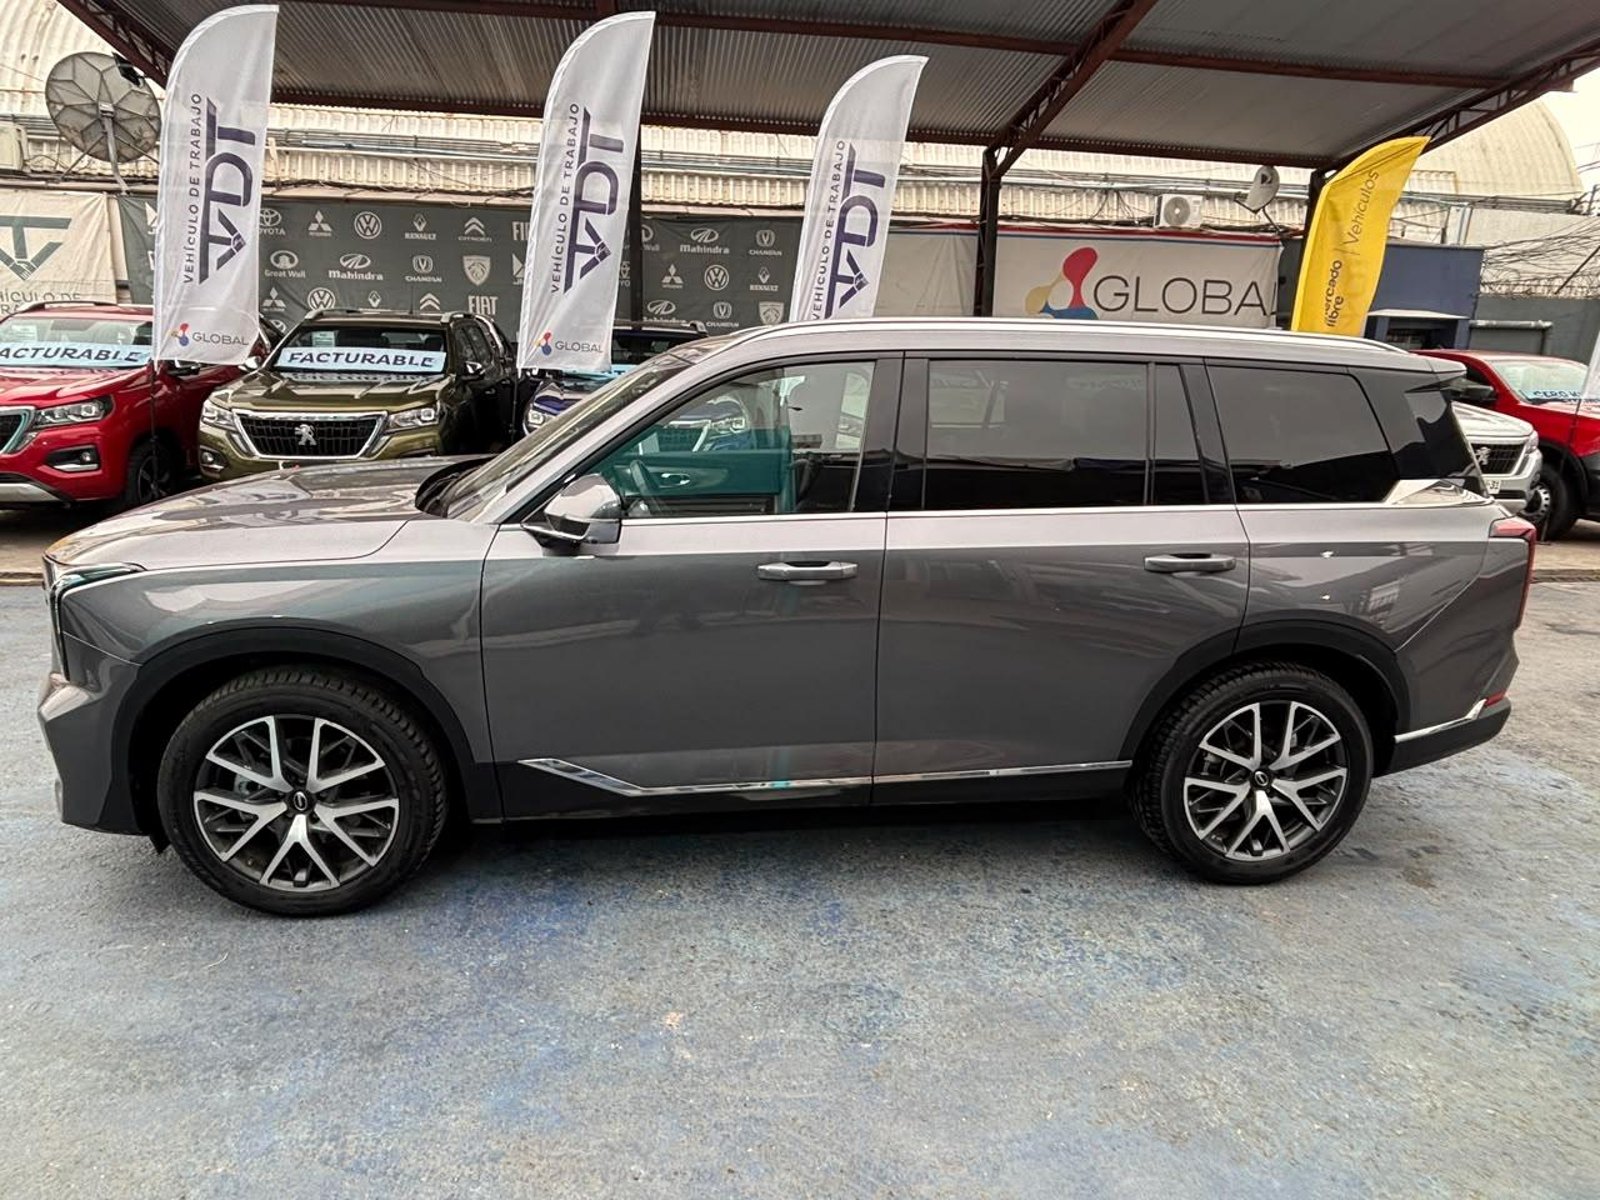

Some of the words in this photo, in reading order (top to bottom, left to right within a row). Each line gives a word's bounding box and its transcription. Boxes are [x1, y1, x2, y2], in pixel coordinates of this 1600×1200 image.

[189, 93, 202, 171] TRABAJO
[564, 103, 580, 179] TRABAJO
[828, 140, 846, 212] TRABAJO
[189, 177, 200, 197] DE
[559, 187, 570, 206] DE
[259, 228, 286, 236] OYOTA
[825, 219, 835, 239] DE
[183, 204, 199, 284] VEHÍCULO
[551, 212, 568, 293] VEHÍCULO
[680, 244, 730, 255] Mahindra
[264, 269, 286, 279] Great
[328, 269, 384, 281] Mahindra
[468, 295, 498, 316] FIAT
[1327, 296, 1345, 327] libre
[192, 331, 250, 347] GLOBAL
[554, 340, 604, 354] GLOBAL
[0, 346, 144, 363] ACTURABLE
[287, 351, 435, 368] FACTURABLE
